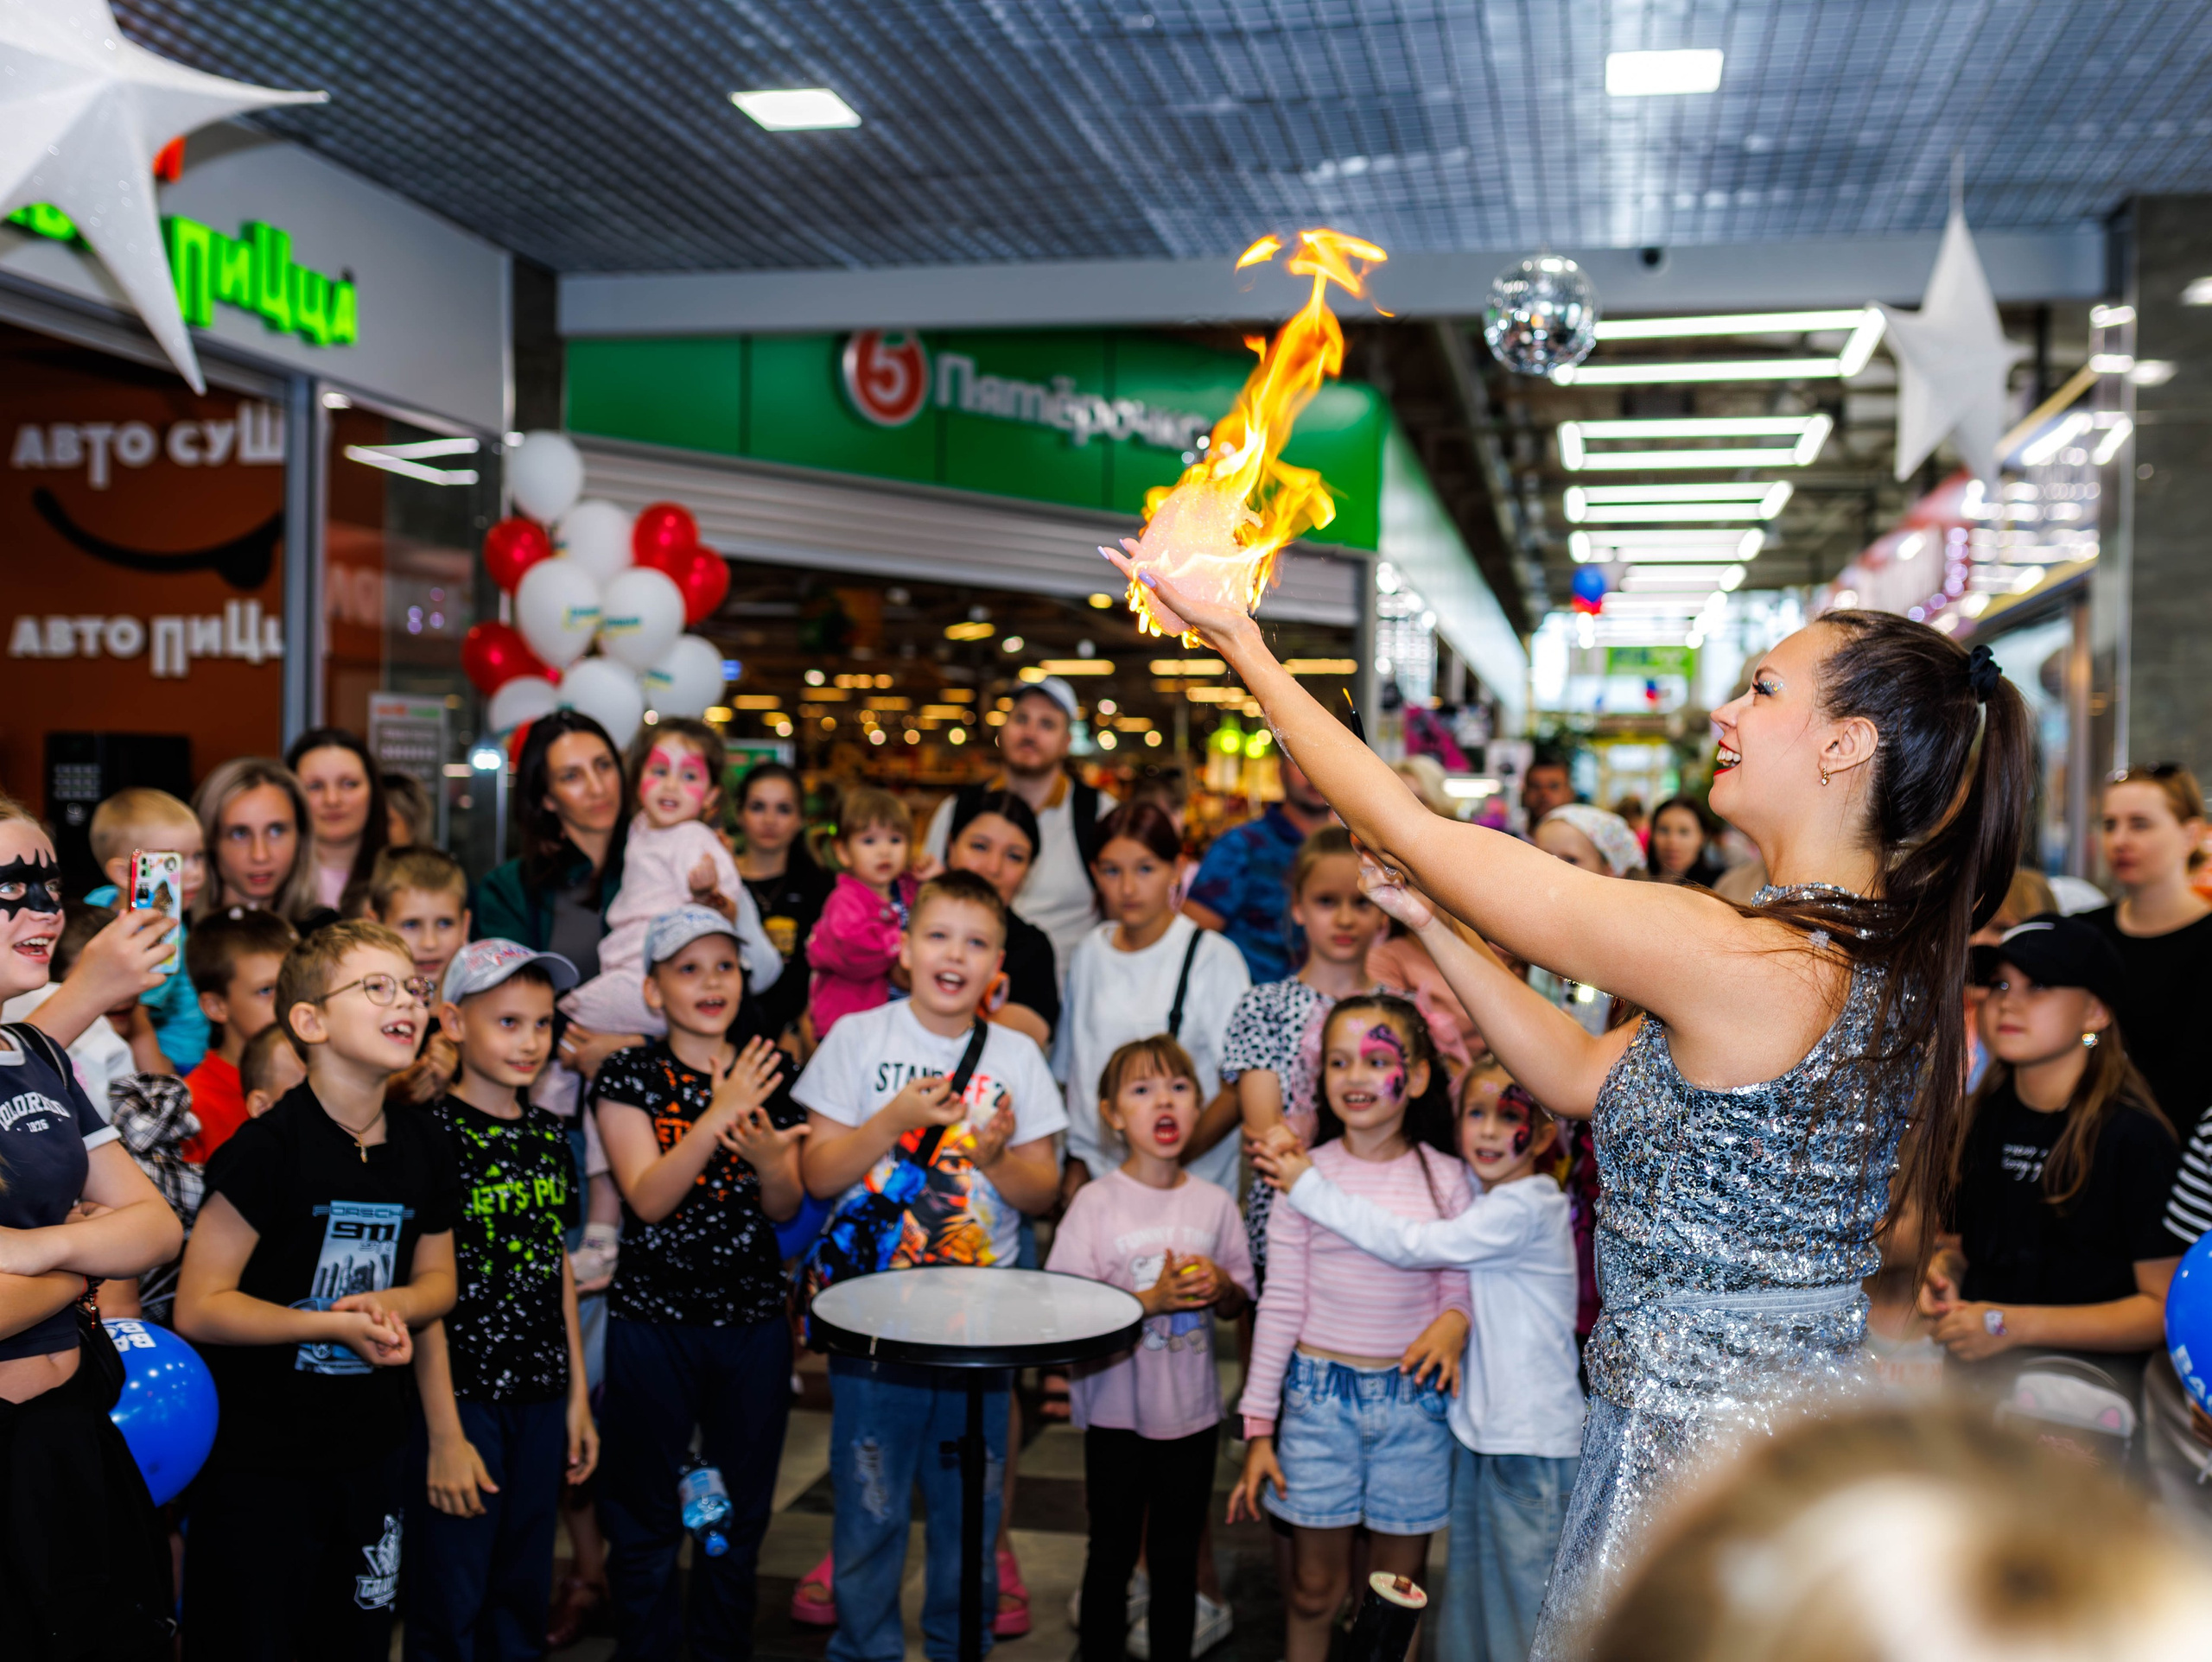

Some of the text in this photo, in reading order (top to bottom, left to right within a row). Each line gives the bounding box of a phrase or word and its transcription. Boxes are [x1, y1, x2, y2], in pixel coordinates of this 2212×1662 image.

[10, 400, 286, 491] АВТО СУШ
[9, 613, 146, 659] АВТО
[0, 1091, 71, 1132] OLORADO
[331, 1221, 396, 1241] 911
